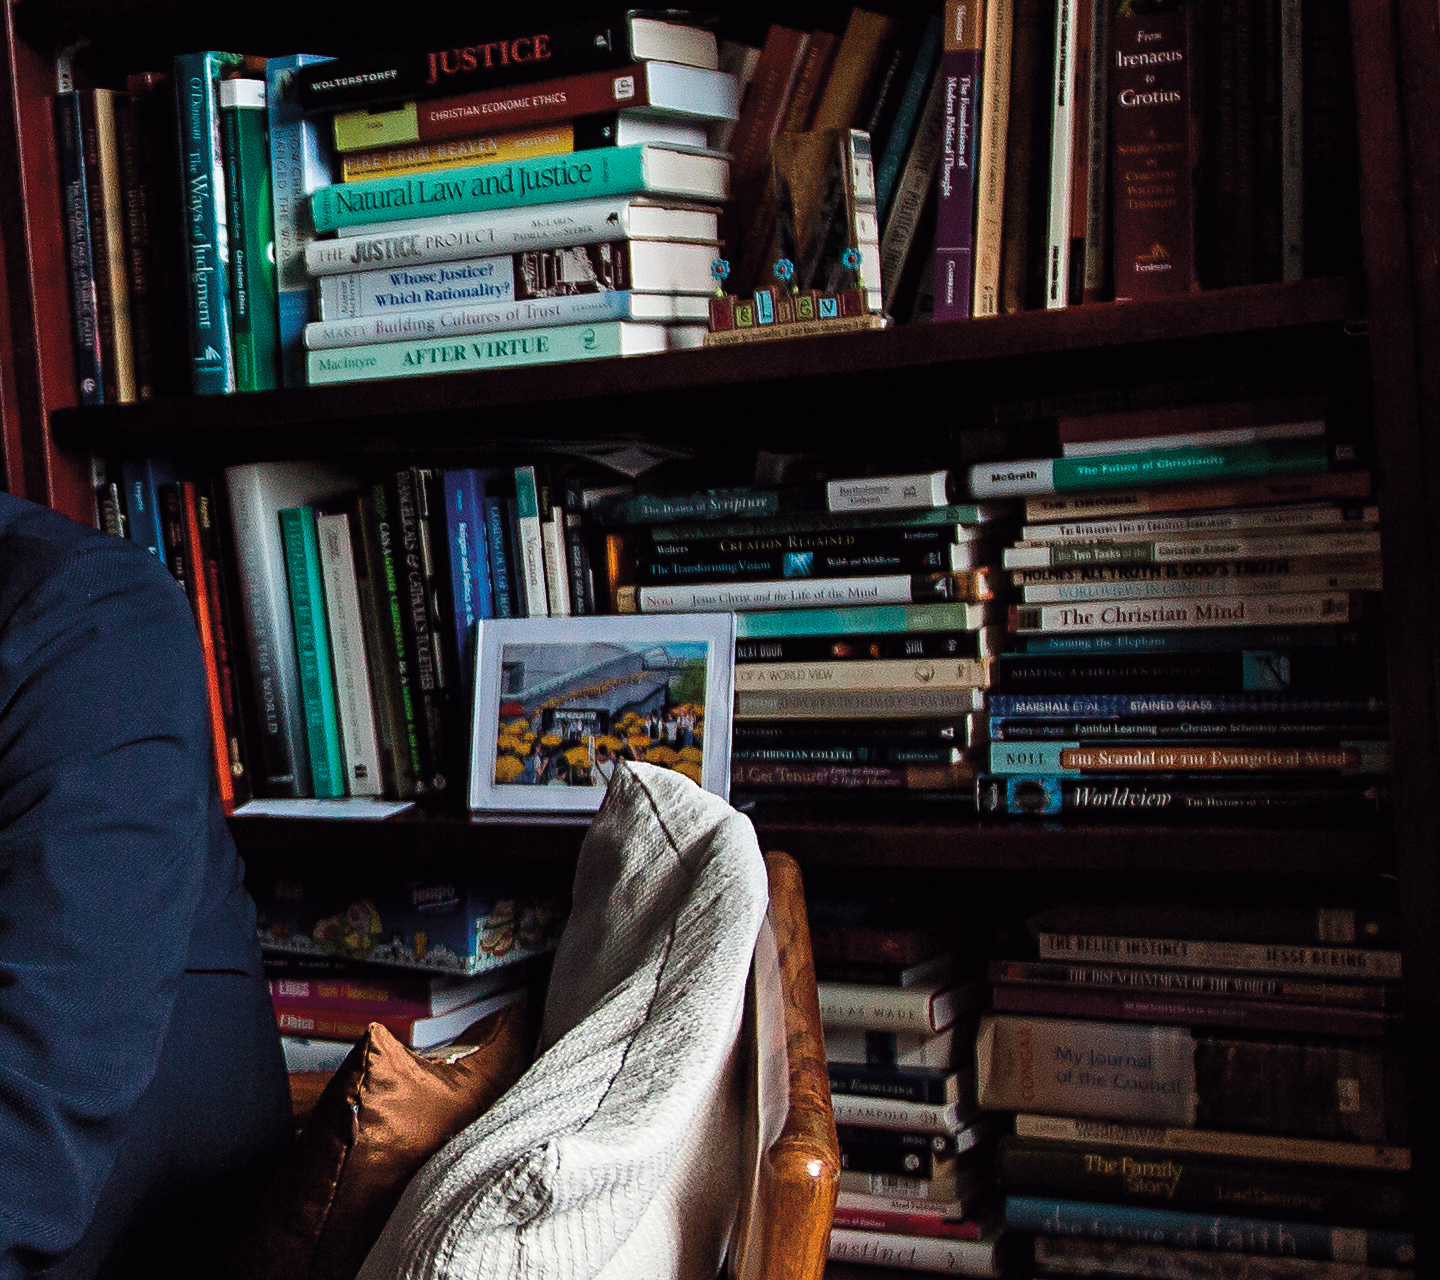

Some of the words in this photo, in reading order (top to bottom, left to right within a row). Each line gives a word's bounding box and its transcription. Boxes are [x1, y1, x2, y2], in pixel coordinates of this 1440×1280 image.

[425, 33, 552, 86] JUSTICE
[1115, 50, 1183, 67] Irenaeus
[312, 68, 398, 92] WOLTERSTORFF
[430, 104, 480, 122] CHRISTIAN
[480, 97, 530, 116] ECONOMIC
[531, 91, 567, 109] ETHICS
[1120, 90, 1181, 107] Grotius
[336, 183, 414, 216] Natural
[419, 176, 467, 204] Law
[472, 170, 514, 198] and
[518, 158, 593, 195] Justice
[389, 270, 436, 286] Whose
[438, 264, 495, 284] Justice?
[374, 289, 416, 306] Which
[422, 281, 510, 302] Rationality?
[403, 344, 467, 368] AFTER
[472, 336, 550, 362] VIRTUE
[720, 538, 783, 552] CREATION
[787, 533, 855, 547] REGAINED
[1060, 609, 1095, 627] The
[1100, 605, 1187, 624] Christian
[1192, 603, 1246, 620] Mind
[1073, 787, 1172, 808] Worldview
